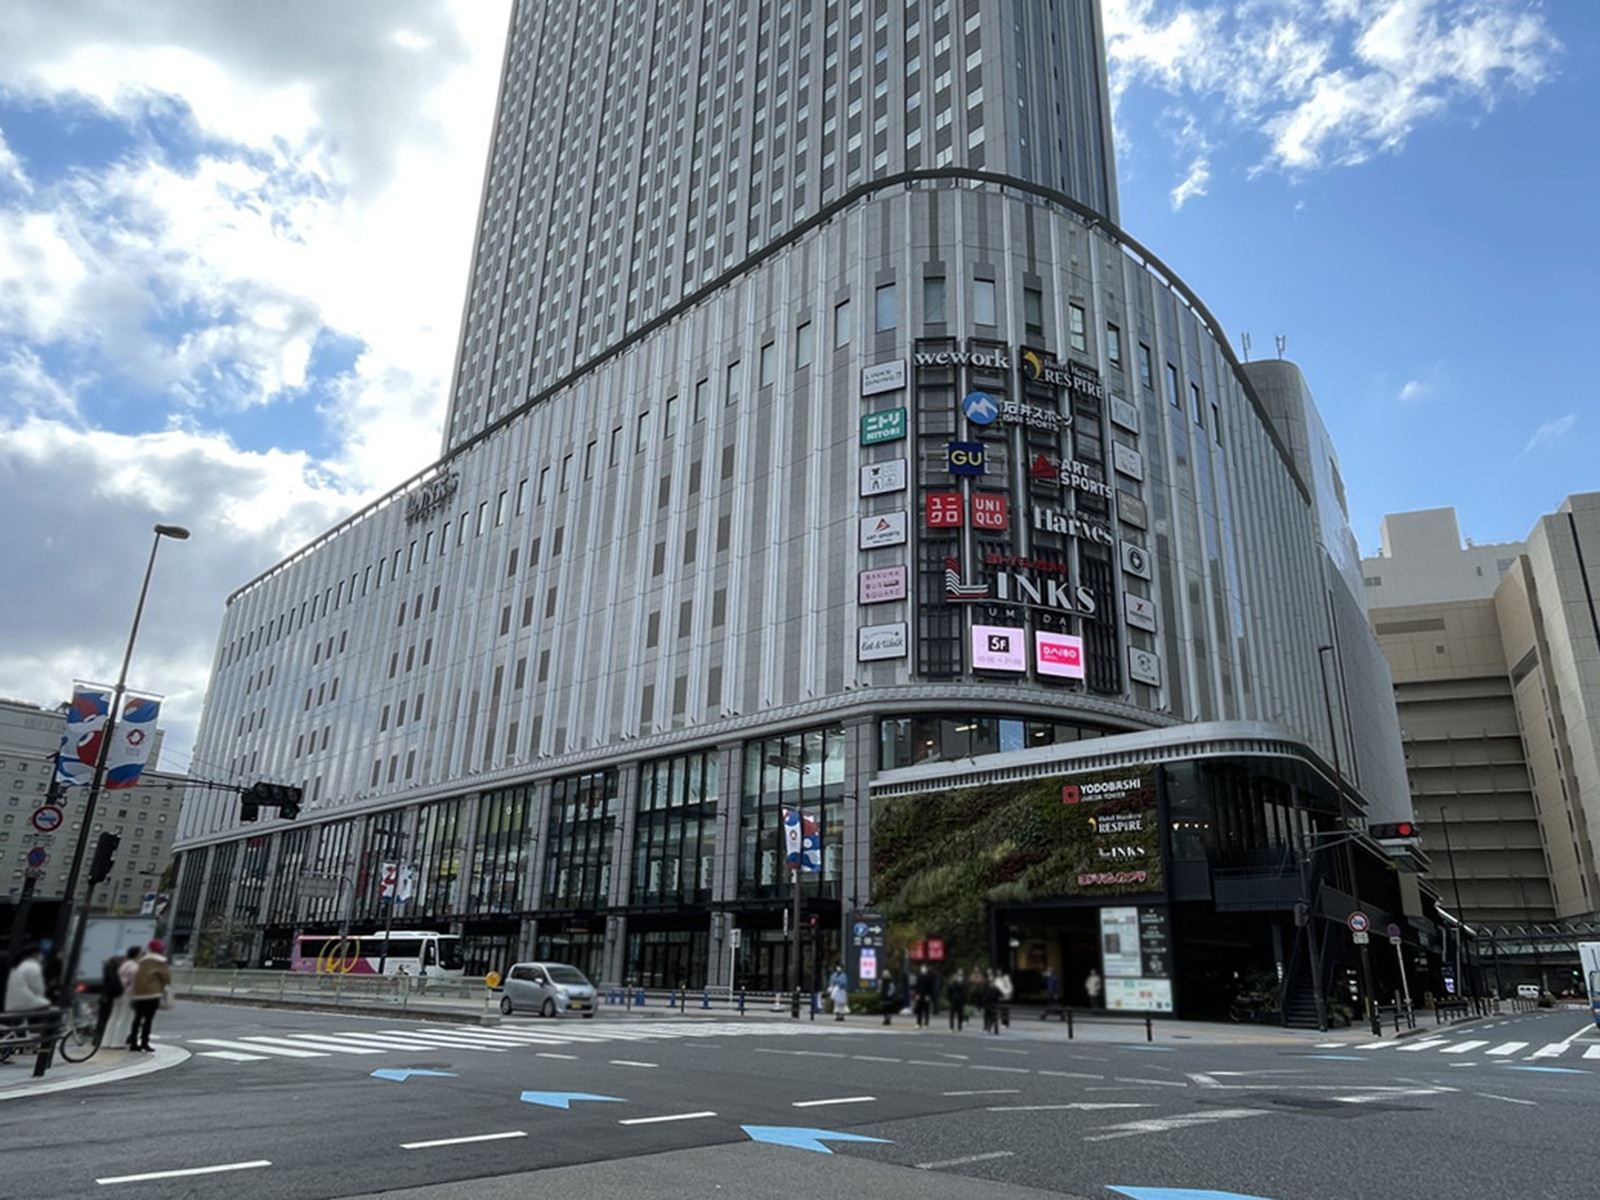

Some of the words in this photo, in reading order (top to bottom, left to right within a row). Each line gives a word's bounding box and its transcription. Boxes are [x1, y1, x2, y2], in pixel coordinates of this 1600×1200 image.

[914, 348, 1010, 369] wework
[1044, 368, 1104, 399] RESPIRE
[867, 412, 900, 431] ニトリ
[866, 427, 901, 440] NITORI
[951, 449, 982, 466] GU
[1060, 458, 1090, 477] ART
[1060, 473, 1114, 499] SPORTS
[931, 497, 957, 510] ユニ
[975, 498, 1001, 512] UNI
[930, 511, 958, 523] クロ
[976, 512, 1003, 525] QLO
[1034, 506, 1114, 546] Harves
[944, 555, 1096, 614] LINKS
[990, 636, 1007, 651] 5F
[1080, 778, 1141, 795] YODOBASHI
[1098, 820, 1143, 834] RESPIRE
